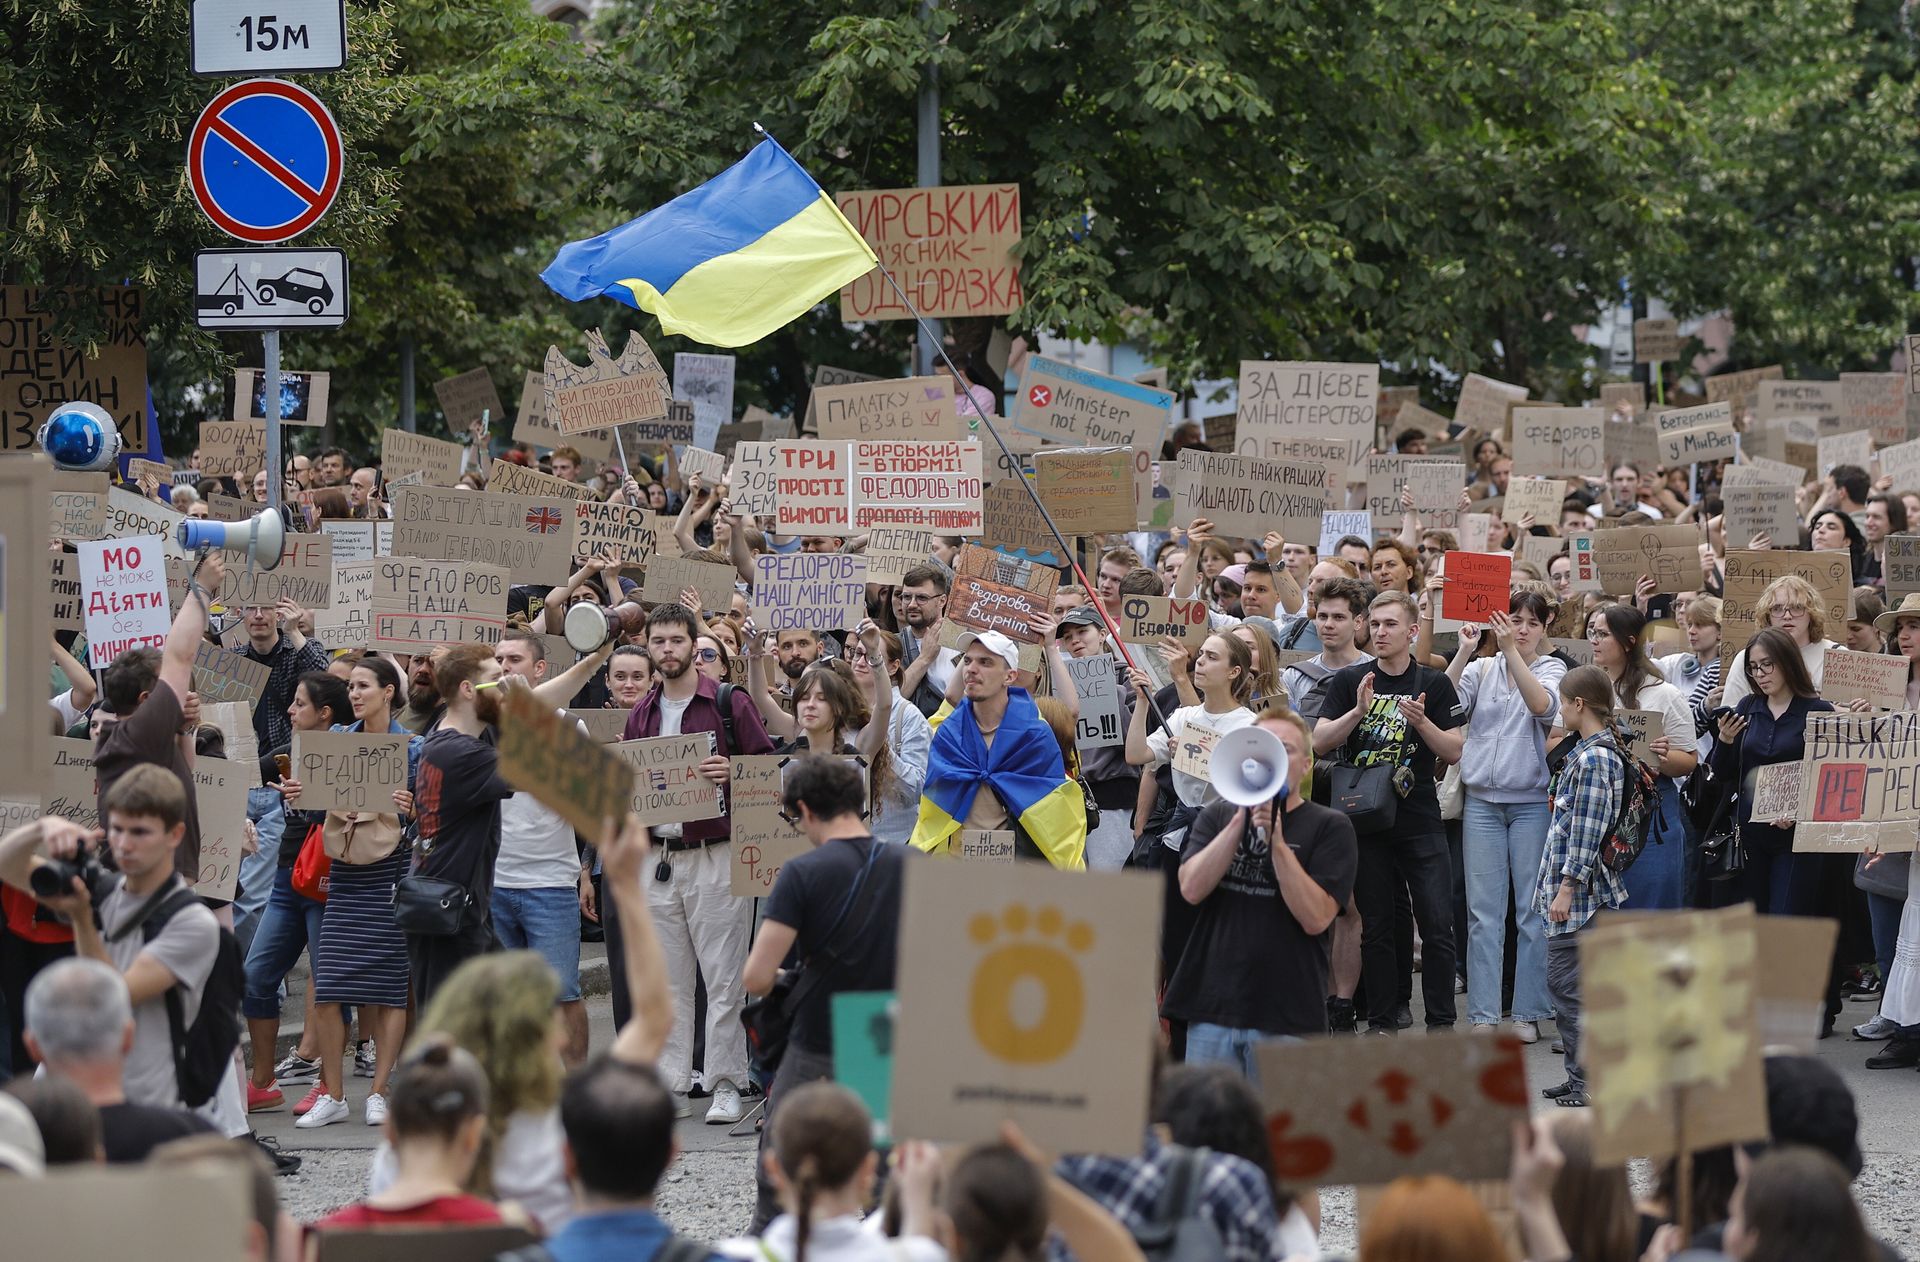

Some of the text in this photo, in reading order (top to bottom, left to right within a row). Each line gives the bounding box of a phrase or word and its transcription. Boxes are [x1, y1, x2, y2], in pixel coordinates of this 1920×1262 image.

[558, 376, 657, 407] ВИ ПРОБУДИЛИ
[1248, 371, 1370, 401] ЗА ДІЄВЕ
[560, 390, 665, 431] КАРТОНОДРАКОНА
[827, 391, 911, 424] ПАЛАТКУ
[1055, 386, 1131, 425] Minister
[1236, 401, 1374, 427] МІНІСТЕРСТВО
[637, 421, 694, 442] ФЕДОРОВА
[859, 410, 914, 434] ВЗЯВ
[1050, 412, 1136, 446] not found
[1525, 424, 1602, 445] ФЕДОРОВ
[205, 424, 267, 446] ДОНАТ
[780, 447, 836, 471] ТРИ
[858, 441, 960, 458] СИРСЬКИЙ
[1271, 441, 1299, 457] THE
[1303, 442, 1346, 462] POWER
[1560, 446, 1598, 470] МО
[1179, 451, 1245, 479] ЗНІМАЮТЬ
[1249, 461, 1327, 490] НАЙКРАЩИХ
[1369, 458, 1401, 475] НАМ
[777, 477, 845, 497] ПРОСТІ
[860, 476, 981, 500] ФЕДОРОВ-МО
[402, 490, 522, 530] BRITAIN
[778, 505, 848, 525] ВИМОГИ
[1258, 490, 1325, 520] СЛУХНЯНИХ
[400, 527, 441, 544] STANDS
[867, 527, 934, 554] ПОВЕРНІТЬ
[102, 546, 143, 573] МО
[442, 534, 544, 570] FEDOROV
[96, 572, 115, 588] не
[119, 568, 155, 587] може
[381, 562, 502, 596] ФЕДОРОВ
[88, 590, 164, 617] Діяти
[407, 597, 469, 614] НАША
[754, 579, 865, 608] НАШ МІНІСТР
[968, 580, 1034, 615] Федорова
[112, 612, 144, 634] без
[769, 607, 845, 630] ОБОРОНИ
[1123, 598, 1187, 638] ФЕДОРОВ
[1167, 598, 1207, 626] МО
[650, 741, 698, 764] ВСІМ
[302, 752, 405, 786] ФЕДОРОВ
[335, 785, 367, 808] МО
[979, 831, 993, 845] НІ
